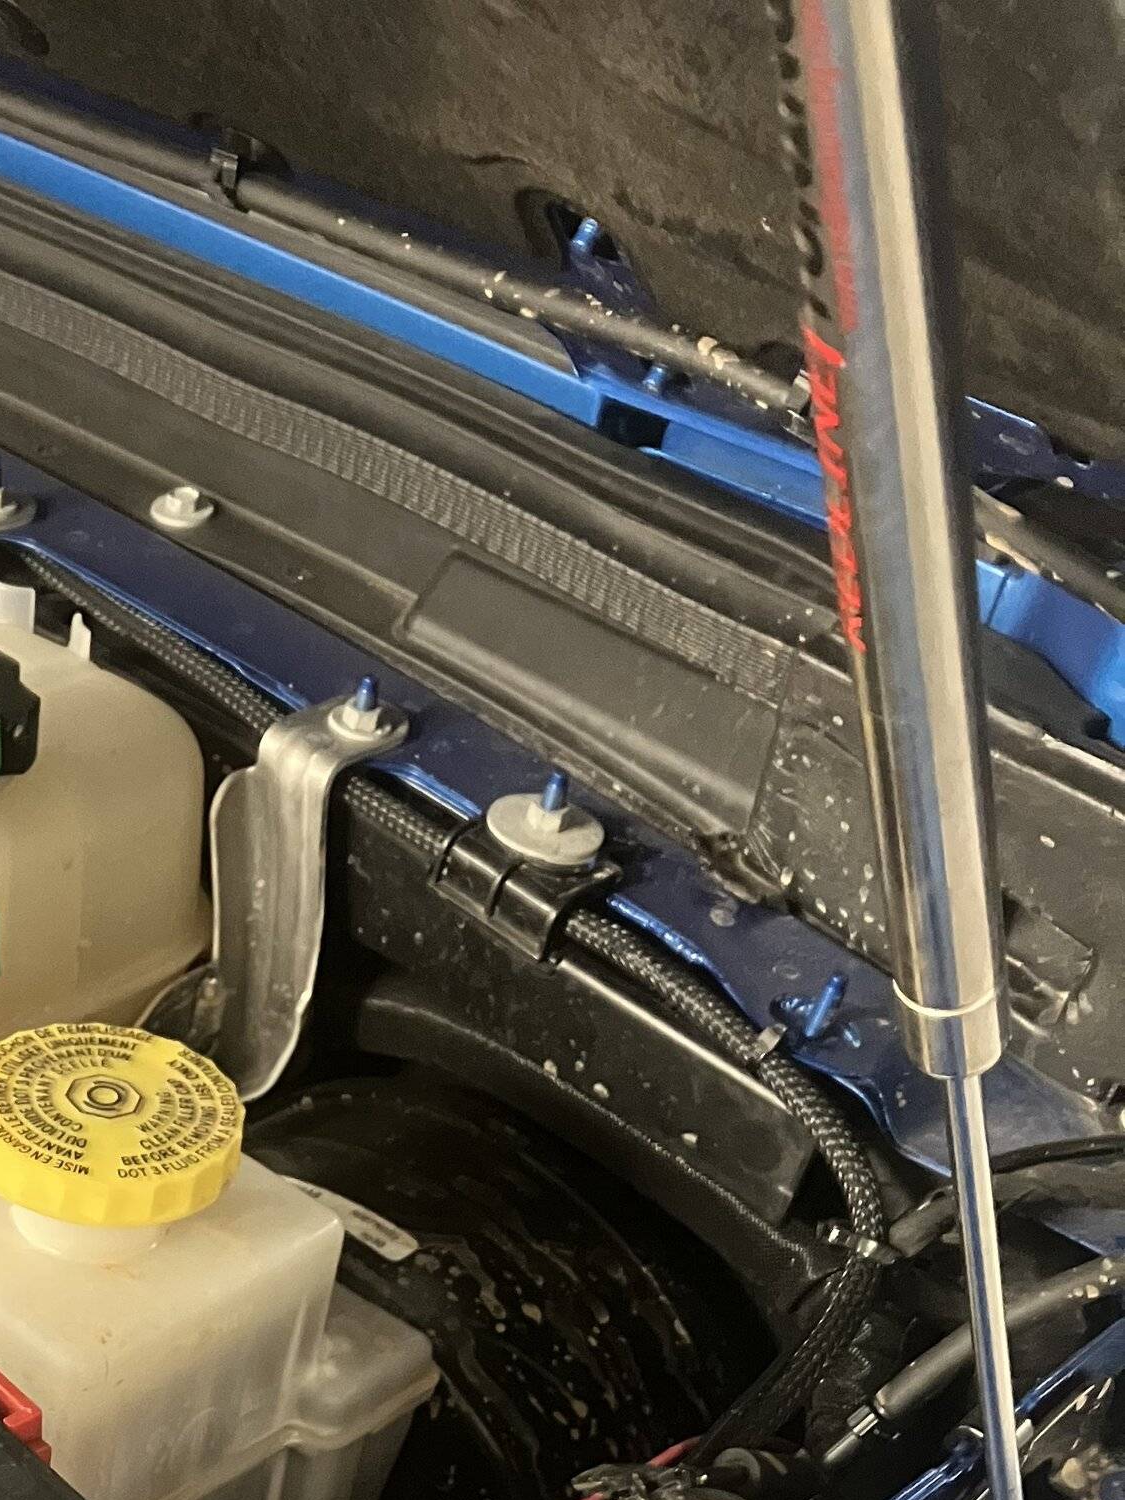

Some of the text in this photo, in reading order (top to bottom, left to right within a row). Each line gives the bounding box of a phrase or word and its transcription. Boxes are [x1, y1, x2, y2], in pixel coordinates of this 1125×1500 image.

[3, 1114, 24, 1128] LE
[17, 1126, 39, 1141] DE
[139, 1127, 181, 1150] CLEAN
[35, 1138, 84, 1160] AVANT
[65, 1135, 88, 1149] DU
[30, 1150, 53, 1164] EN
[117, 1168, 147, 1178] DOT
[150, 1165, 162, 1176] 3
[161, 1153, 200, 1173] FLUID
[195, 1134, 226, 1158] FROM
[120, 1146, 181, 1166] BEFORE
[53, 1159, 90, 1175] MISE
